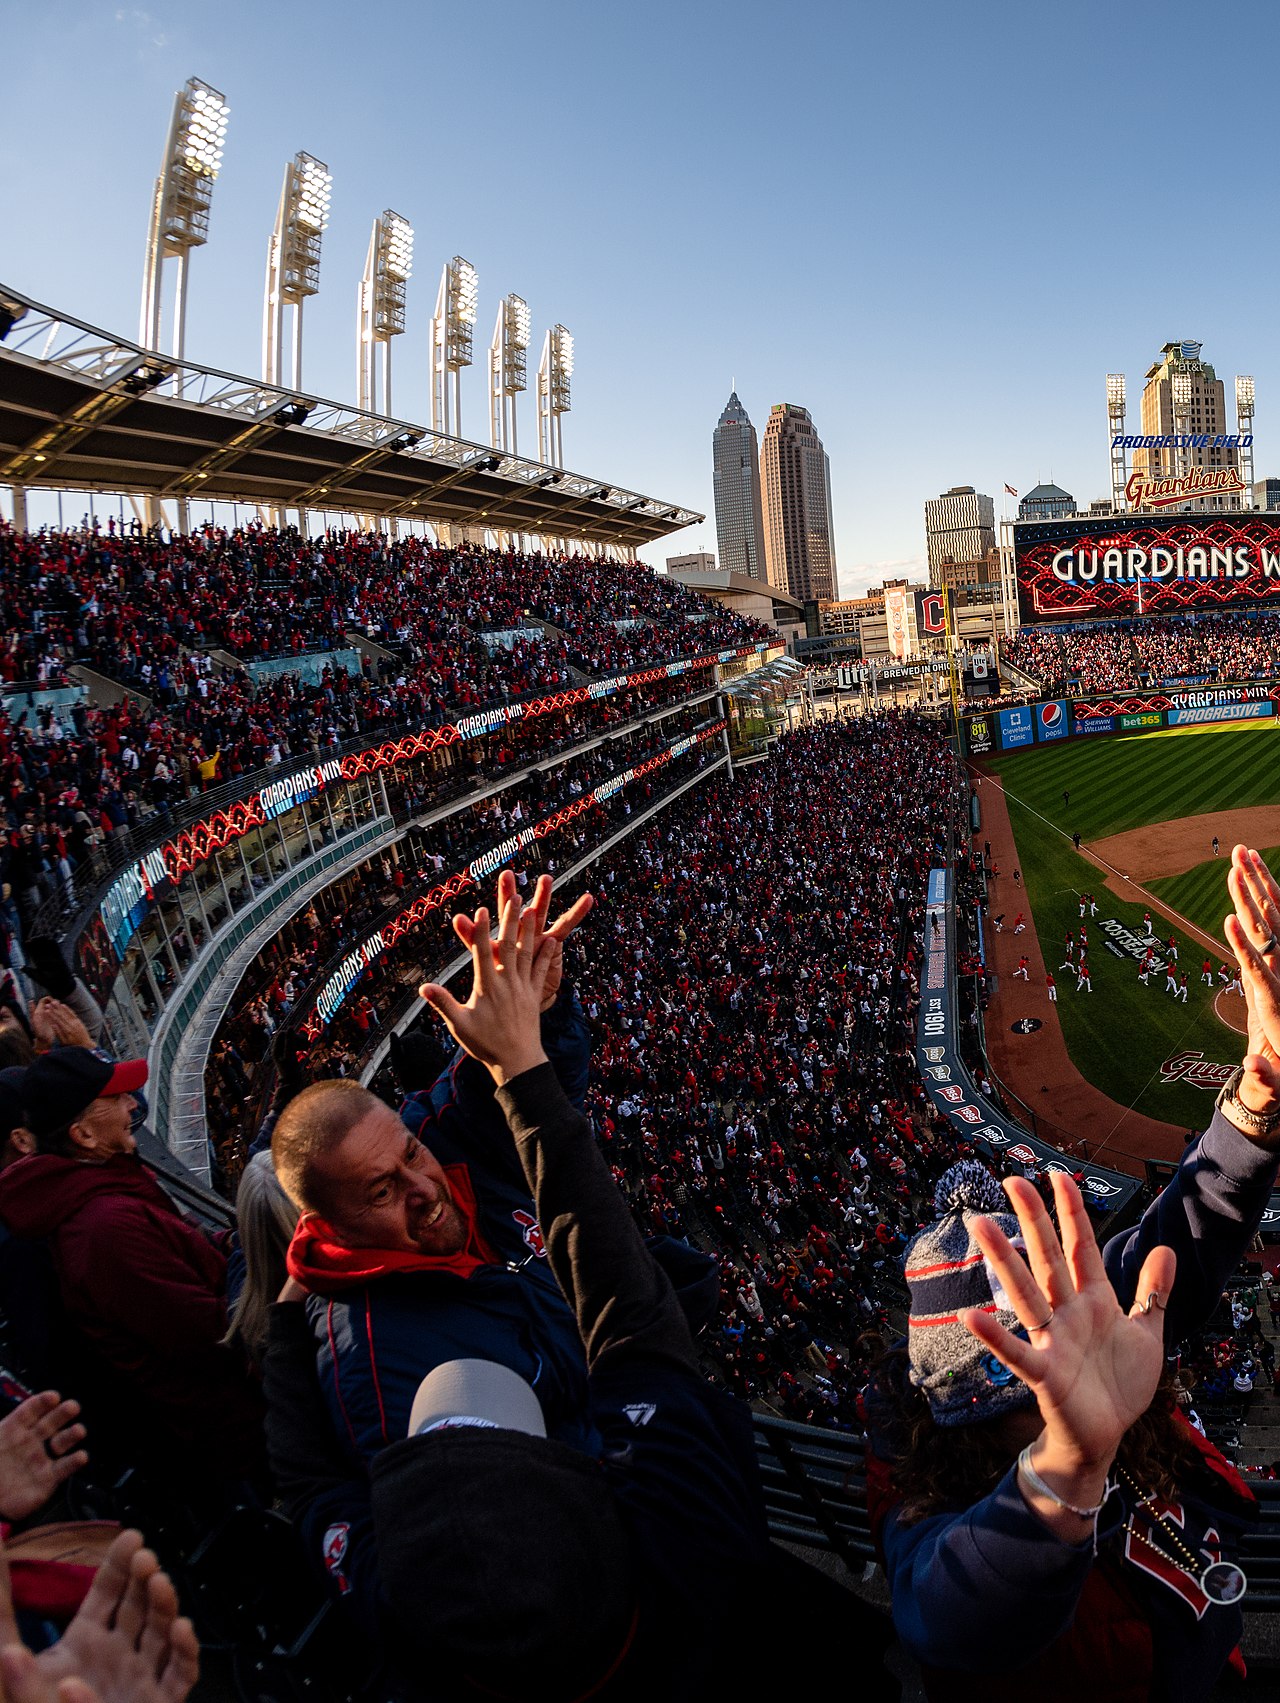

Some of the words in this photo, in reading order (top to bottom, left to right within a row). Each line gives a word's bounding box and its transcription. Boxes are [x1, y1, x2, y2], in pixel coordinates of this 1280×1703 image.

[1179, 361, 1204, 372] at&t
[1112, 435, 1212, 448] PROGRESSIVE
[1213, 434, 1254, 448] FIELD
[1124, 465, 1246, 511] Guardians
[1052, 547, 1250, 581] GUARDIANS
[884, 667, 919, 679] BREWED
[922, 666, 930, 674] IN
[588, 679, 617, 694] GUARDIANS
[1170, 689, 1242, 704] GUARDIANS
[1246, 687, 1268, 698] WIN
[456, 708, 506, 734] GUARDIANS
[506, 704, 522, 719] WIN
[1177, 704, 1262, 724] PROGRESSIVE
[1084, 718, 1111, 726] SHERWIN
[1123, 716, 1160, 727] bet365
[972, 722, 986, 736] 811
[1002, 724, 1031, 736] Cleveland
[1045, 728, 1062, 739] pepsi
[1010, 734, 1026, 742] Clinic
[260, 770, 319, 811] GUARDIANS
[319, 760, 342, 783] WIN
[594, 776, 624, 801] GUARDIANS
[469, 834, 519, 878] GUARDIANS
[518, 826, 536, 846] WIN
[142, 848, 168, 888] WIN
[316, 948, 364, 1020] GUARDIANS
[362, 930, 385, 962] WIN
[930, 998, 942, 1012] EST.
[924, 1010, 945, 1036] 1901
[945, 1086, 959, 1100] 1954
[961, 1108, 978, 1122] 1995
[982, 1128, 1002, 1142] 1996
[1012, 1147, 1033, 1162] 1997
